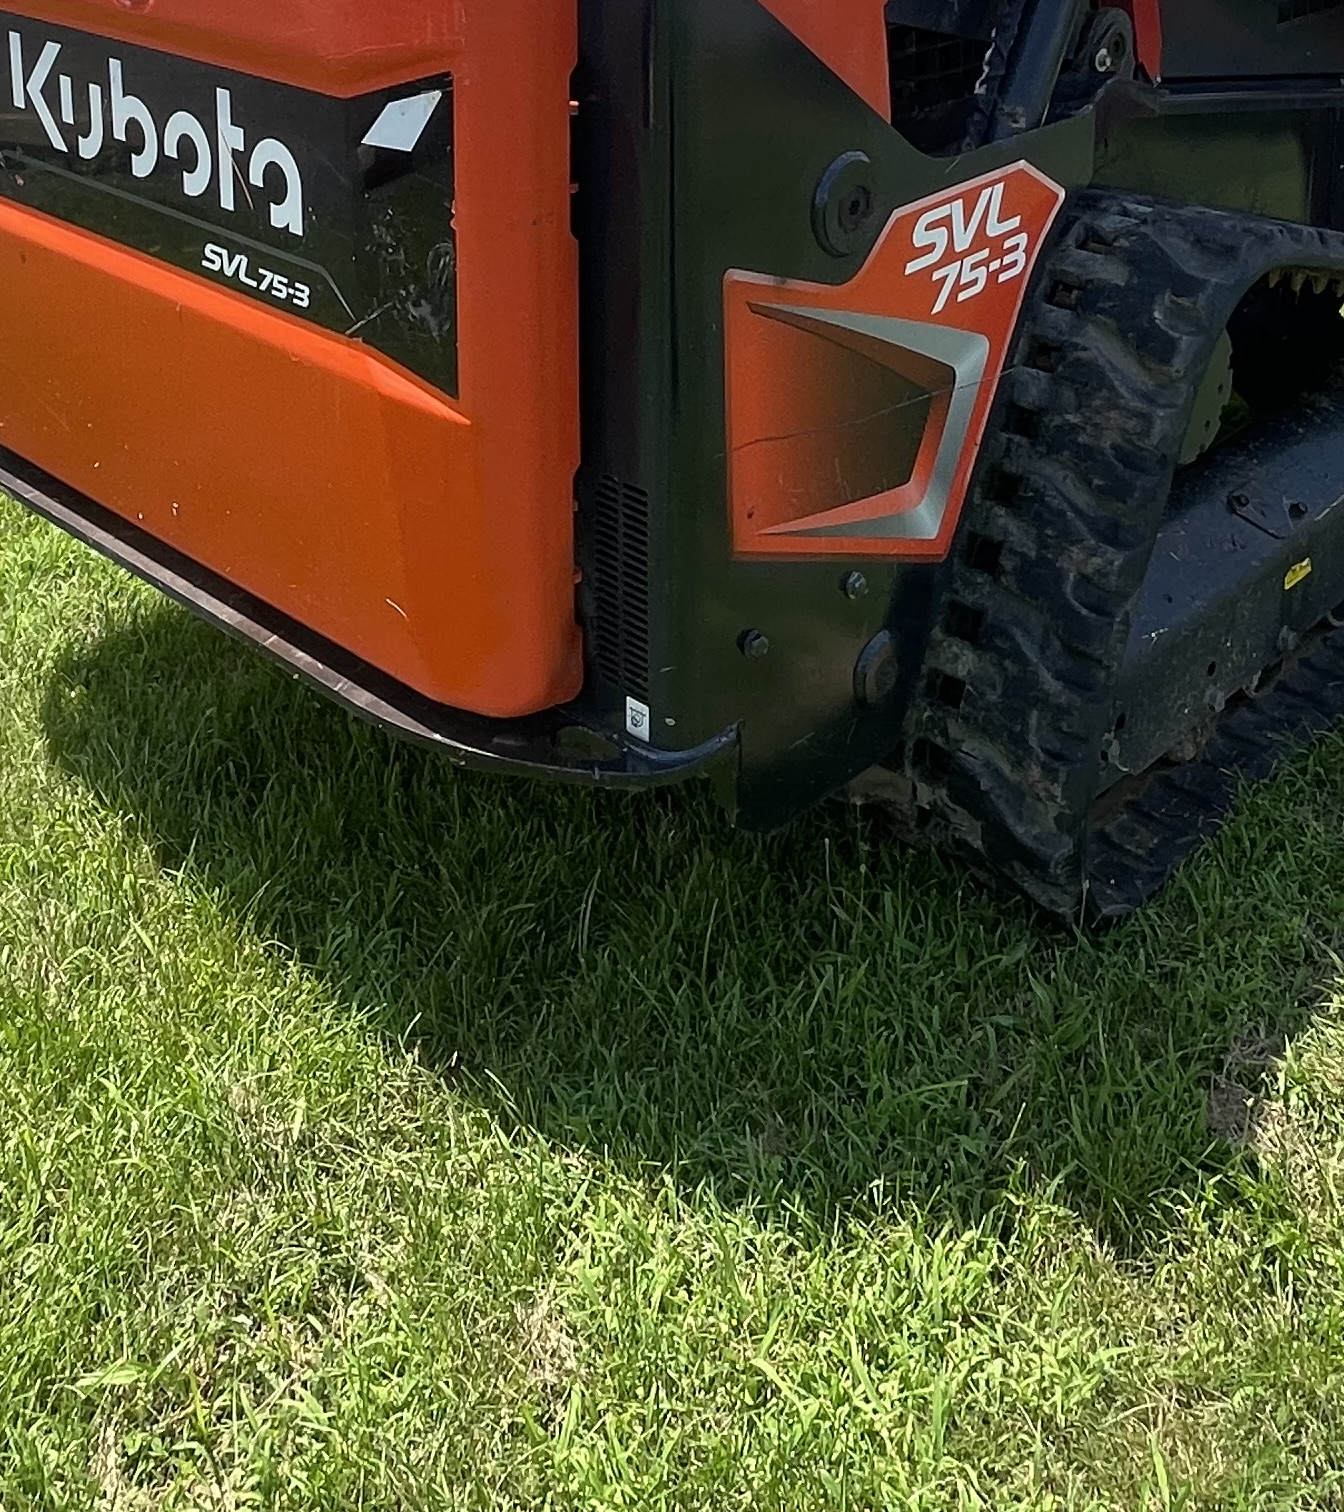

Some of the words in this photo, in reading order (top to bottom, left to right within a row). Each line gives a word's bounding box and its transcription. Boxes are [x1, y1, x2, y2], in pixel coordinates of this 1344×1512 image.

[8, 31, 303, 236] Kubota
[905, 182, 1022, 276] SVL
[931, 232, 1028, 314] 75-3
